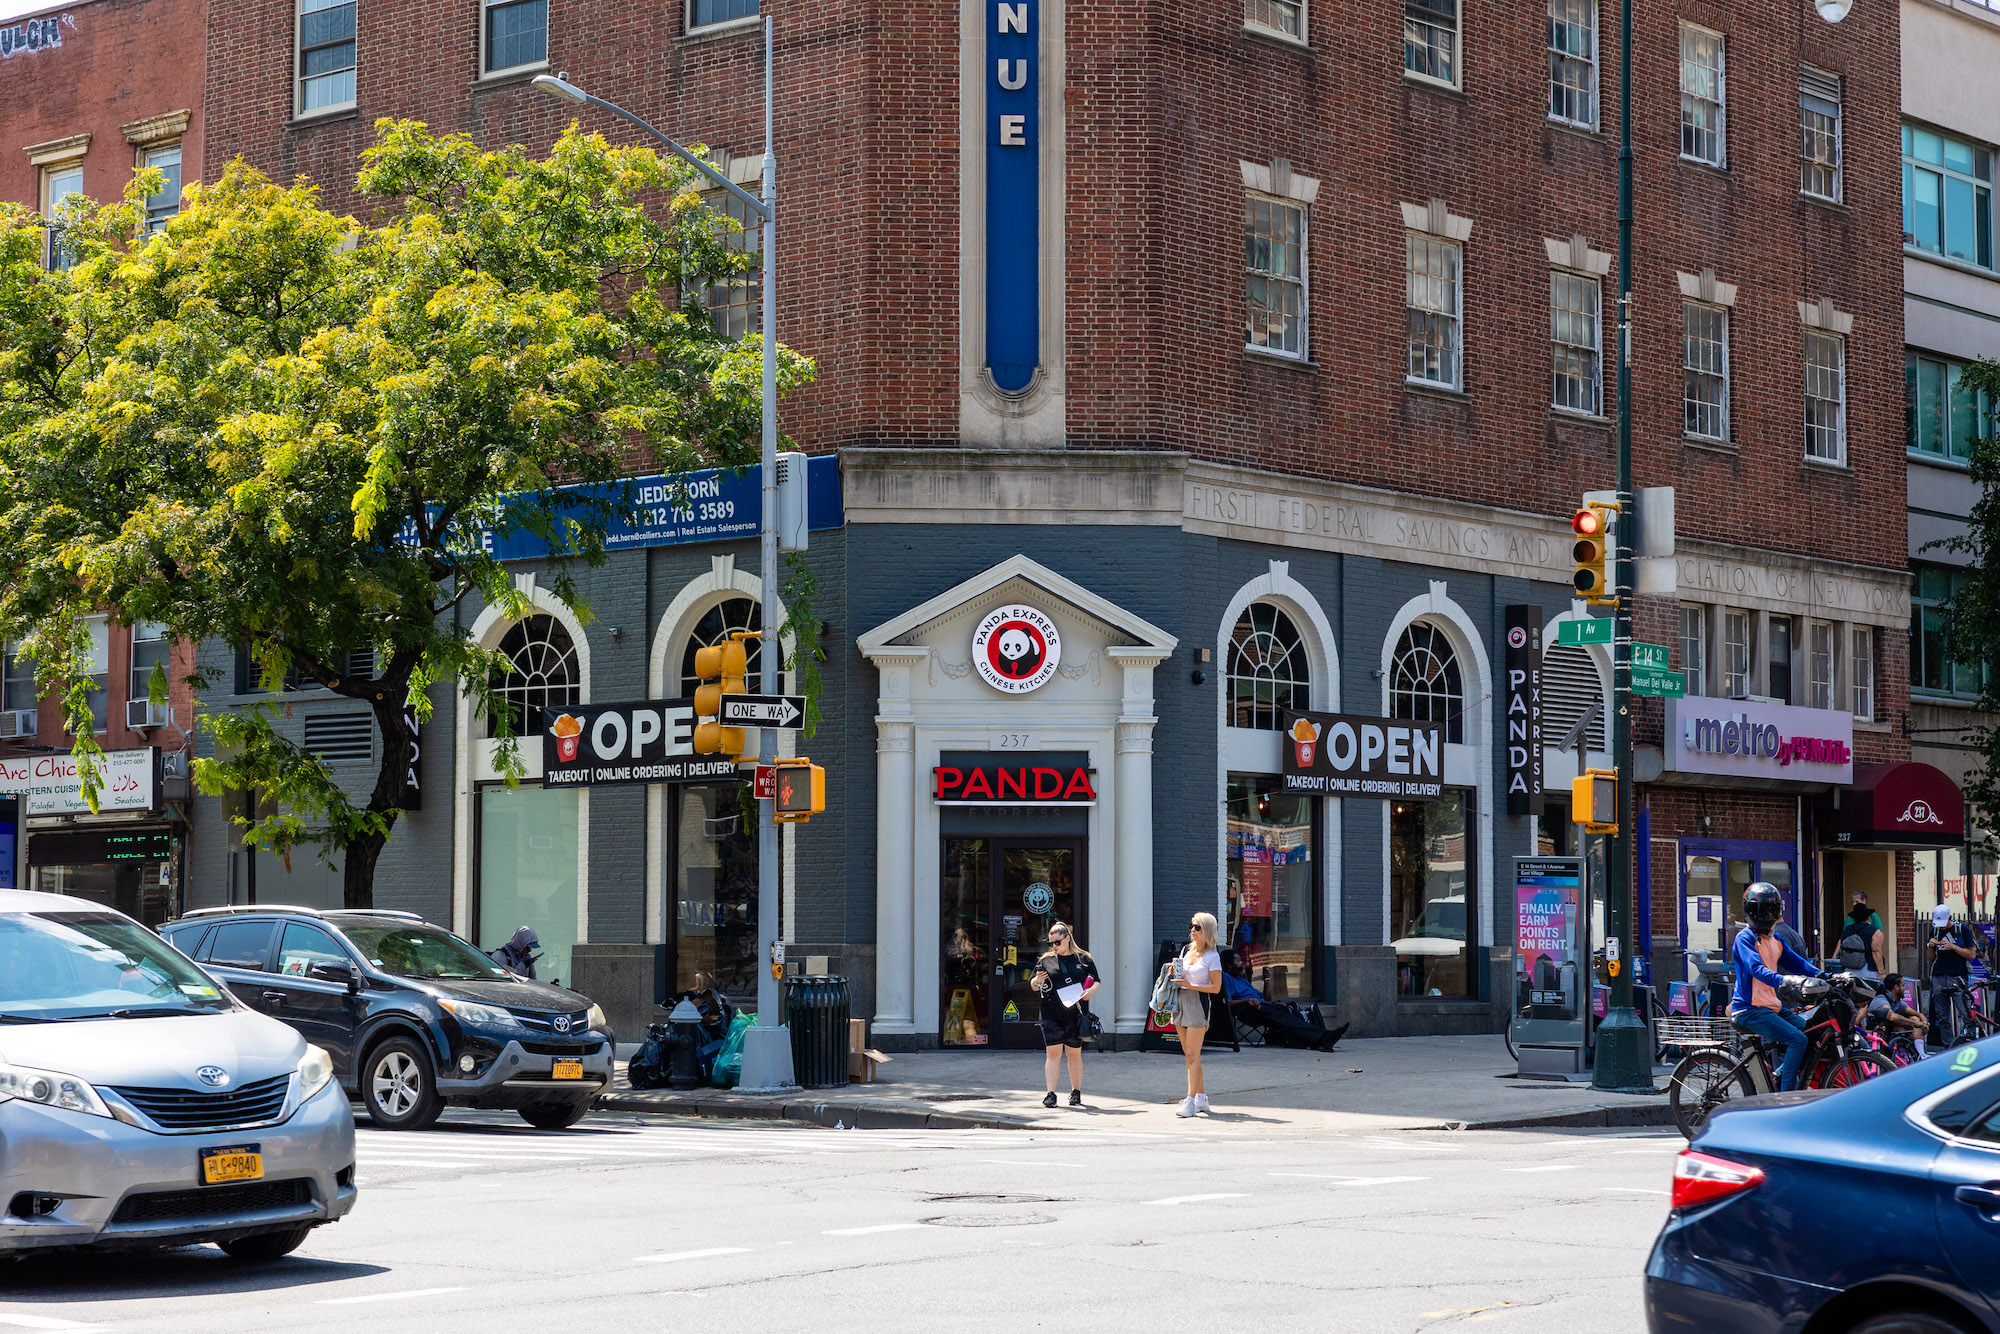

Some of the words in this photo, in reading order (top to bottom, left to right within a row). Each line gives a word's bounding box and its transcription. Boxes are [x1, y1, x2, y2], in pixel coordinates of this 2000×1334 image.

[635, 484, 674, 505] JEDD
[671, 505, 695, 524] 716
[699, 501, 735, 520] 3589
[605, 529, 676, 545] jedd.horn@colliers.com
[681, 527, 696, 536] Real
[696, 524, 717, 534] Estate
[718, 522, 757, 533] Salesperson
[1192, 486, 1251, 522] FIRST
[1279, 499, 1374, 539] FEDERAL
[1396, 515, 1489, 555] SAVINGS
[1508, 536, 1550, 563] AND
[1775, 573, 1796, 598] OF
[1814, 580, 1849, 605] NEW
[1862, 586, 1904, 614] YORK
[977, 611, 1009, 646] PANDA
[1013, 609, 1057, 646] EXPRESS
[1577, 623, 1581, 641] 1
[1586, 623, 1596, 634] Av
[1634, 646, 1640, 665] E
[1644, 647, 1653, 666] 14
[1656, 649, 1663, 661] St
[980, 661, 1015, 690] CHINESE
[1019, 661, 1054, 690] KITCHEN
[1632, 675, 1650, 687] Manuel
[1651, 678, 1660, 688] Del
[1661, 679, 1673, 690] Valle
[732, 704, 757, 717] ONE
[767, 705, 793, 719] WAY
[591, 706, 717, 761] OPE
[1001, 734, 1029, 747] 237
[1507, 669, 1529, 794] PANDA
[1532, 669, 1541, 795] EXPRESS
[1694, 713, 1780, 758] metro
[1779, 736, 1793, 766] by
[125, 752, 144, 760] delivery
[1326, 721, 1439, 777] OPEN
[35, 757, 108, 778] Chicen
[548, 769, 589, 783] TAKEOUT
[596, 766, 632, 781] ONLINE
[633, 764, 681, 778] ORDERING
[689, 761, 736, 776] DELIVERY
[54, 784, 83, 794] CUISIN
[759, 777, 775, 787] WRO
[764, 787, 775, 796] WA
[934, 766, 1097, 799] PANDA
[1286, 775, 1324, 789] TAKEOUT
[1330, 778, 1360, 792] ONLINE
[1361, 780, 1400, 795] ORDERING
[1405, 782, 1441, 796] DELIVERY
[31, 801, 55, 812] Falafel
[114, 796, 145, 806] Seafood
[968, 807, 1061, 818] EXPRESS
[1914, 806, 1925, 818] 237
[1838, 832, 1851, 842] 237
[1519, 903, 1564, 915] FINALLY.
[1519, 915, 1549, 926] EARN
[1519, 926, 1559, 938] POINTS
[1519, 938, 1536, 950] ON
[1538, 939, 1568, 950] RENT.
